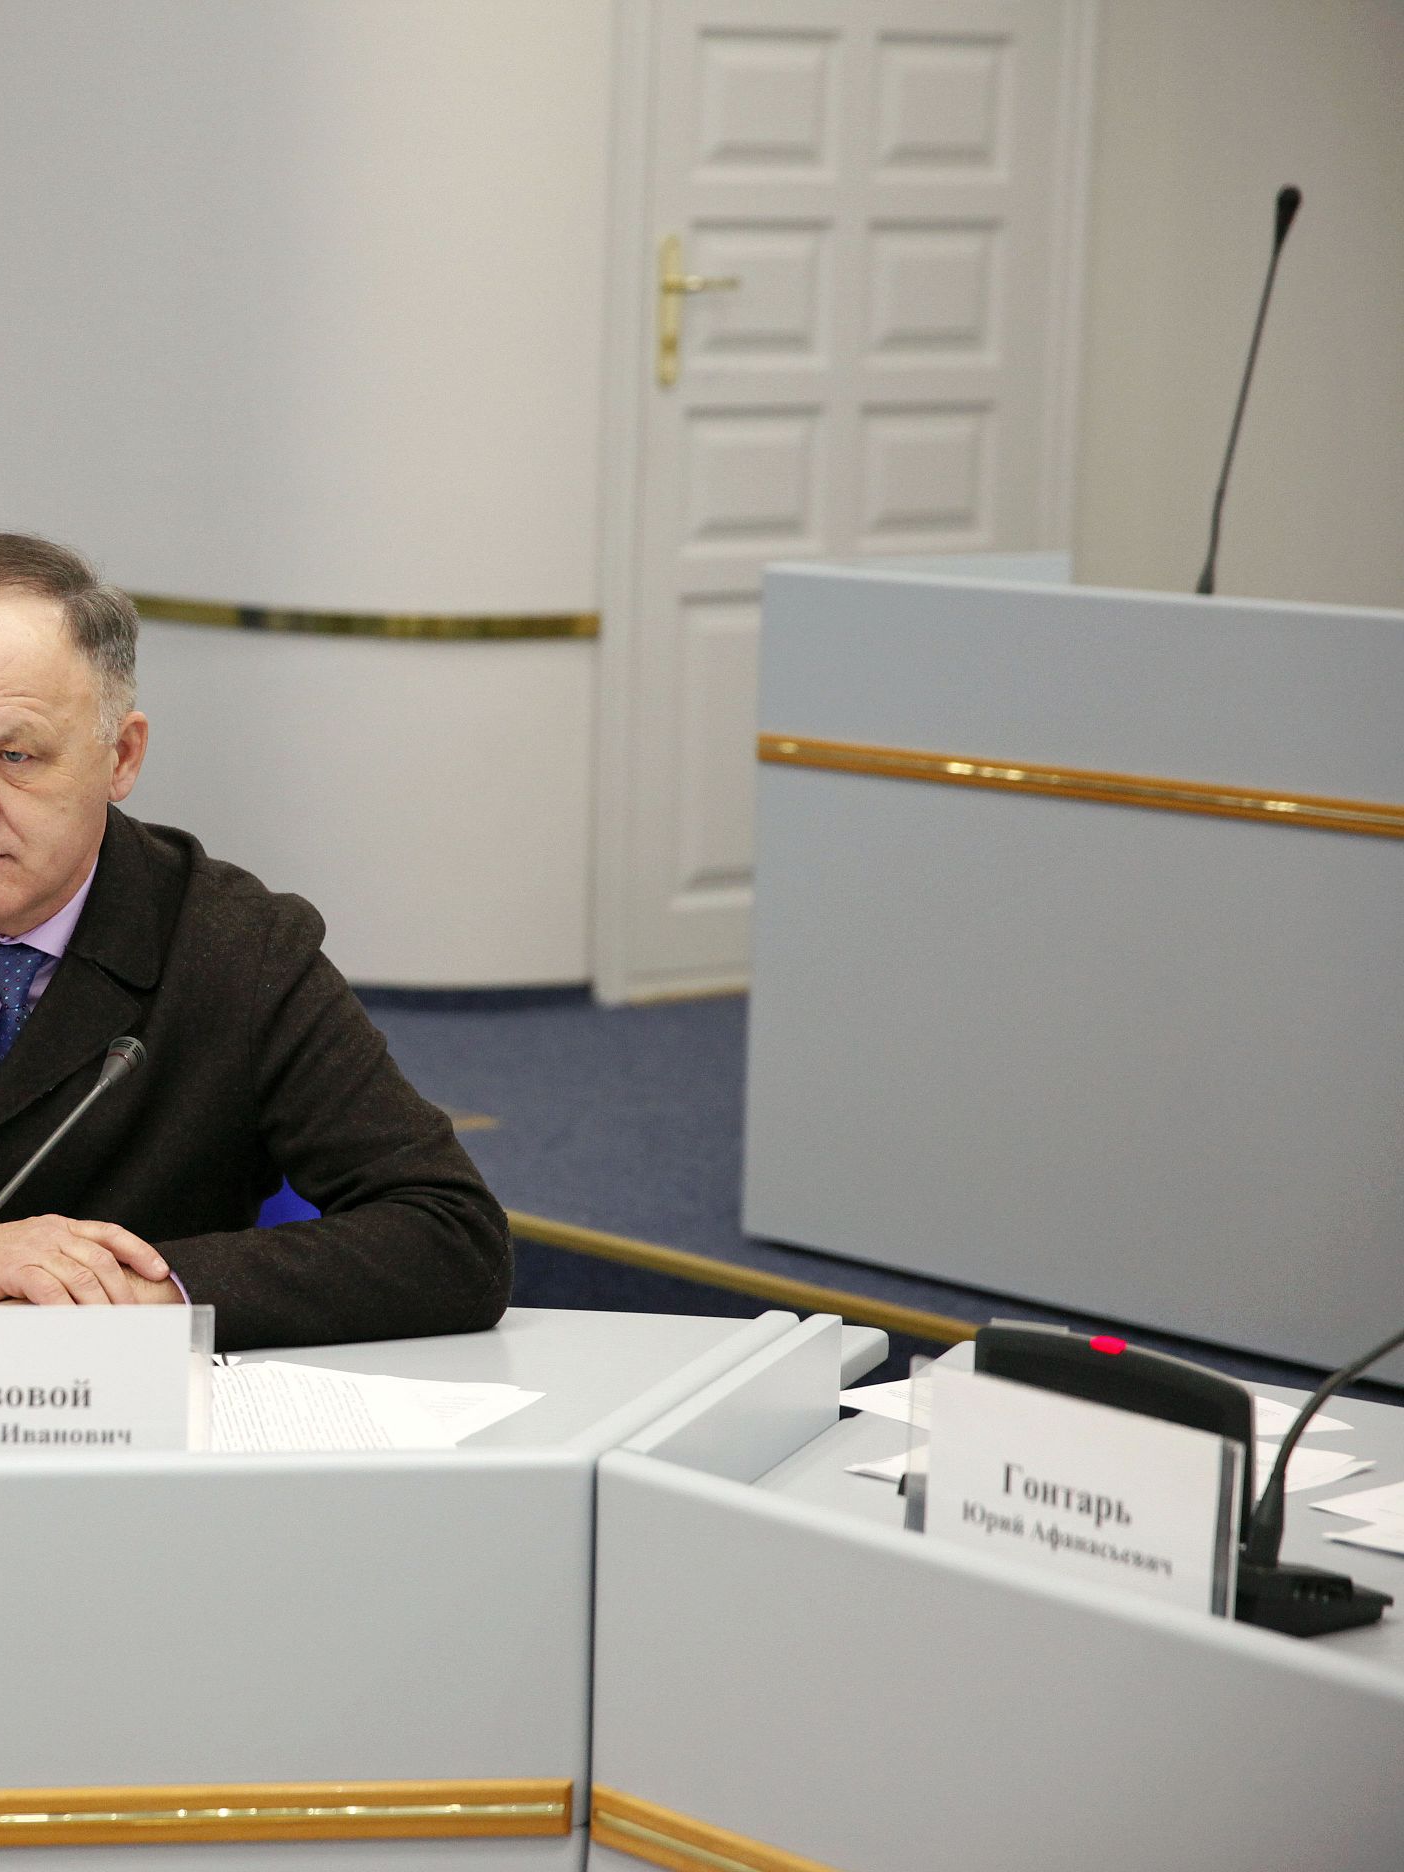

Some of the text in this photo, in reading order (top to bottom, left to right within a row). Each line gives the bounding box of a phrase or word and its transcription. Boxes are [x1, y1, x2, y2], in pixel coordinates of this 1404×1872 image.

[0, 1422, 133, 1445] Иванович
[1003, 1463, 1133, 1528] Гонтарь
[962, 1501, 1174, 1577] Юрий Афанасьевич
